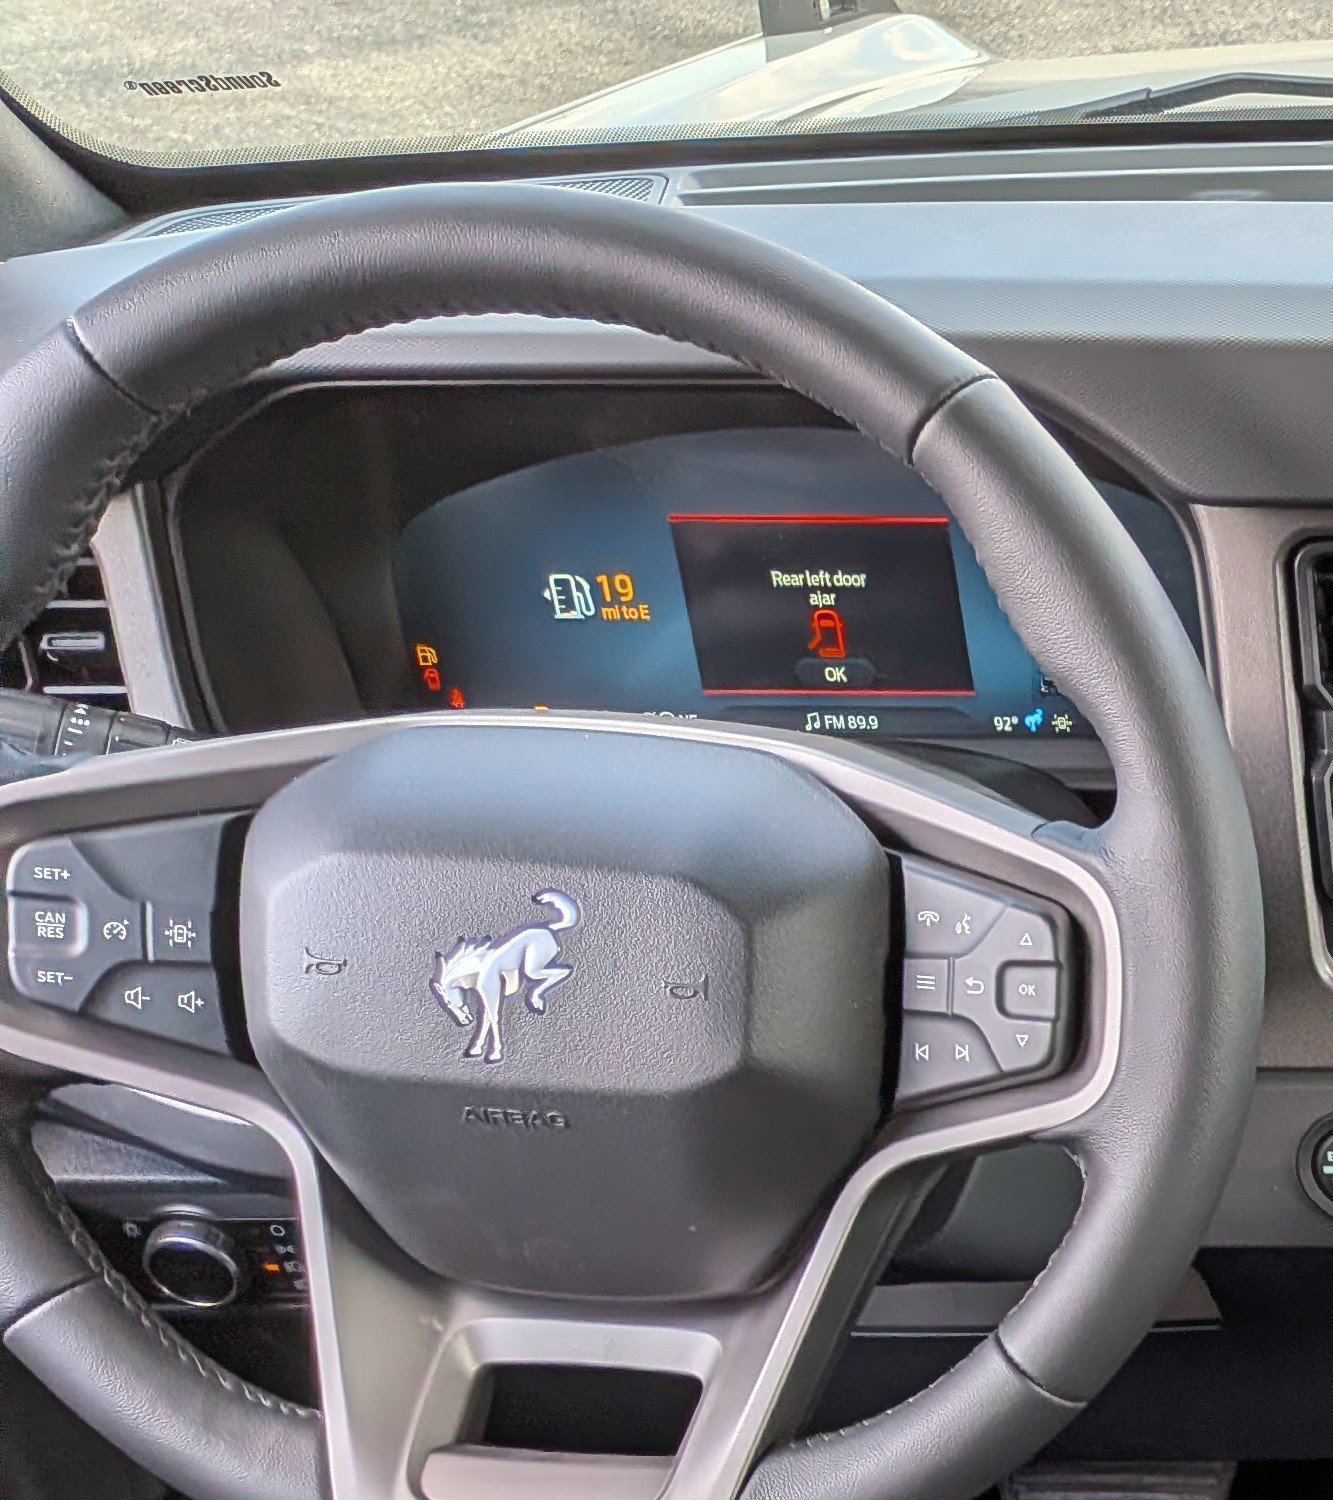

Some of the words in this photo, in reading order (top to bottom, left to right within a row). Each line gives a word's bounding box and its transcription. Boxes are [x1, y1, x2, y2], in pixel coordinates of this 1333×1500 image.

[772, 570, 804, 587] Rear
[806, 570, 829, 587] left
[831, 570, 867, 588] door
[596, 574, 634, 601] 19
[809, 591, 836, 608] ajar
[602, 605, 622, 620] mi
[624, 606, 638, 620] to
[640, 606, 650, 620] E
[824, 666, 847, 682] OK
[824, 716, 845, 729] FM
[848, 716, 879, 730] 89.9
[993, 716, 1018, 730] 92°
[34, 868, 70, 880] SET+
[35, 912, 65, 924] CAN
[37, 927, 64, 938] RES
[1019, 982, 1036, 997] OK
